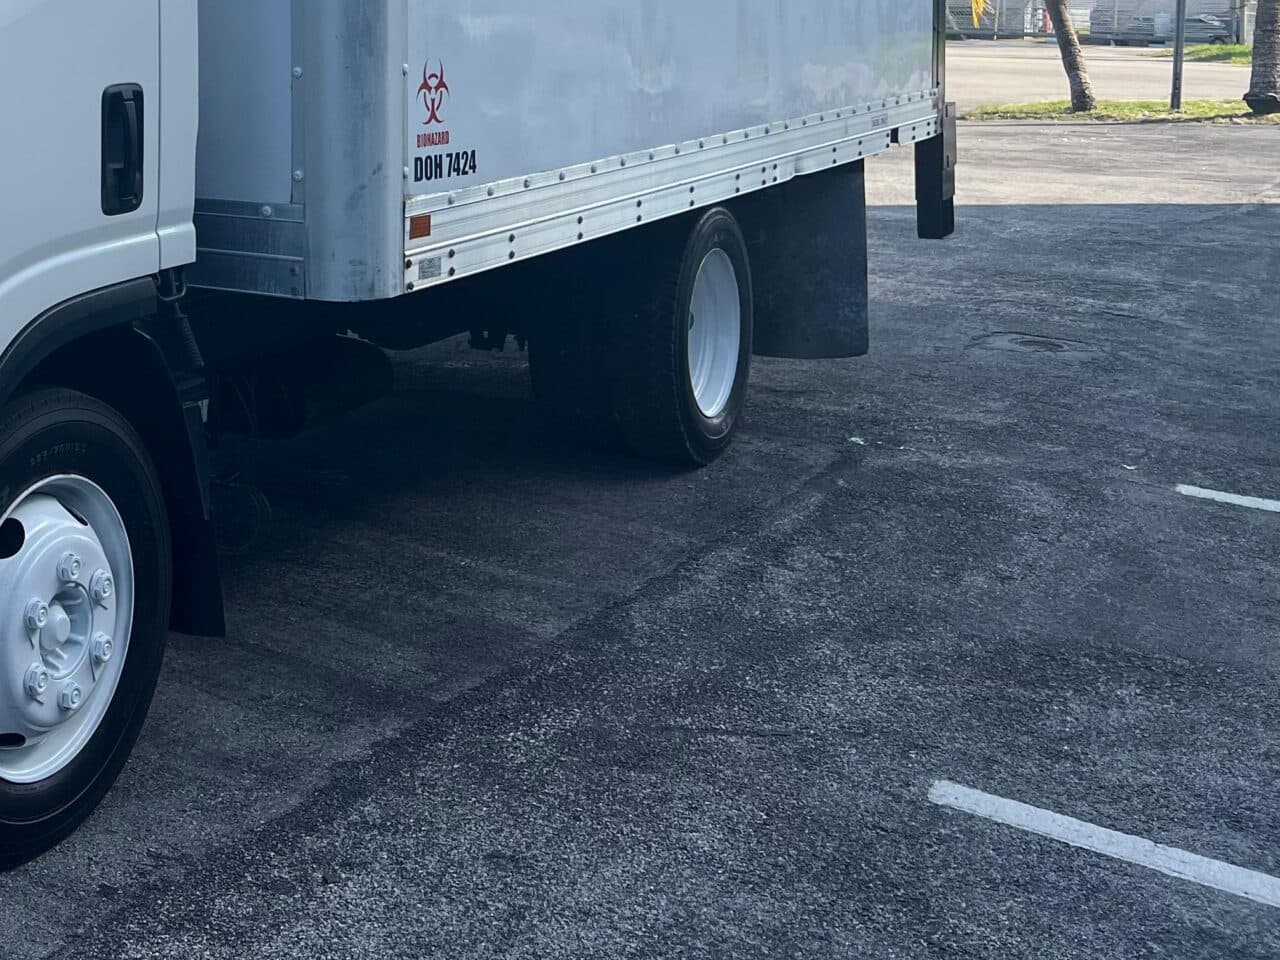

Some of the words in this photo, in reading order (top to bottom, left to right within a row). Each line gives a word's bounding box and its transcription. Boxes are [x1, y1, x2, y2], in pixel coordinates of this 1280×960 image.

[417, 131, 449, 148] BIOHAZARD
[414, 154, 443, 182] DOH
[445, 149, 477, 178] 7424
